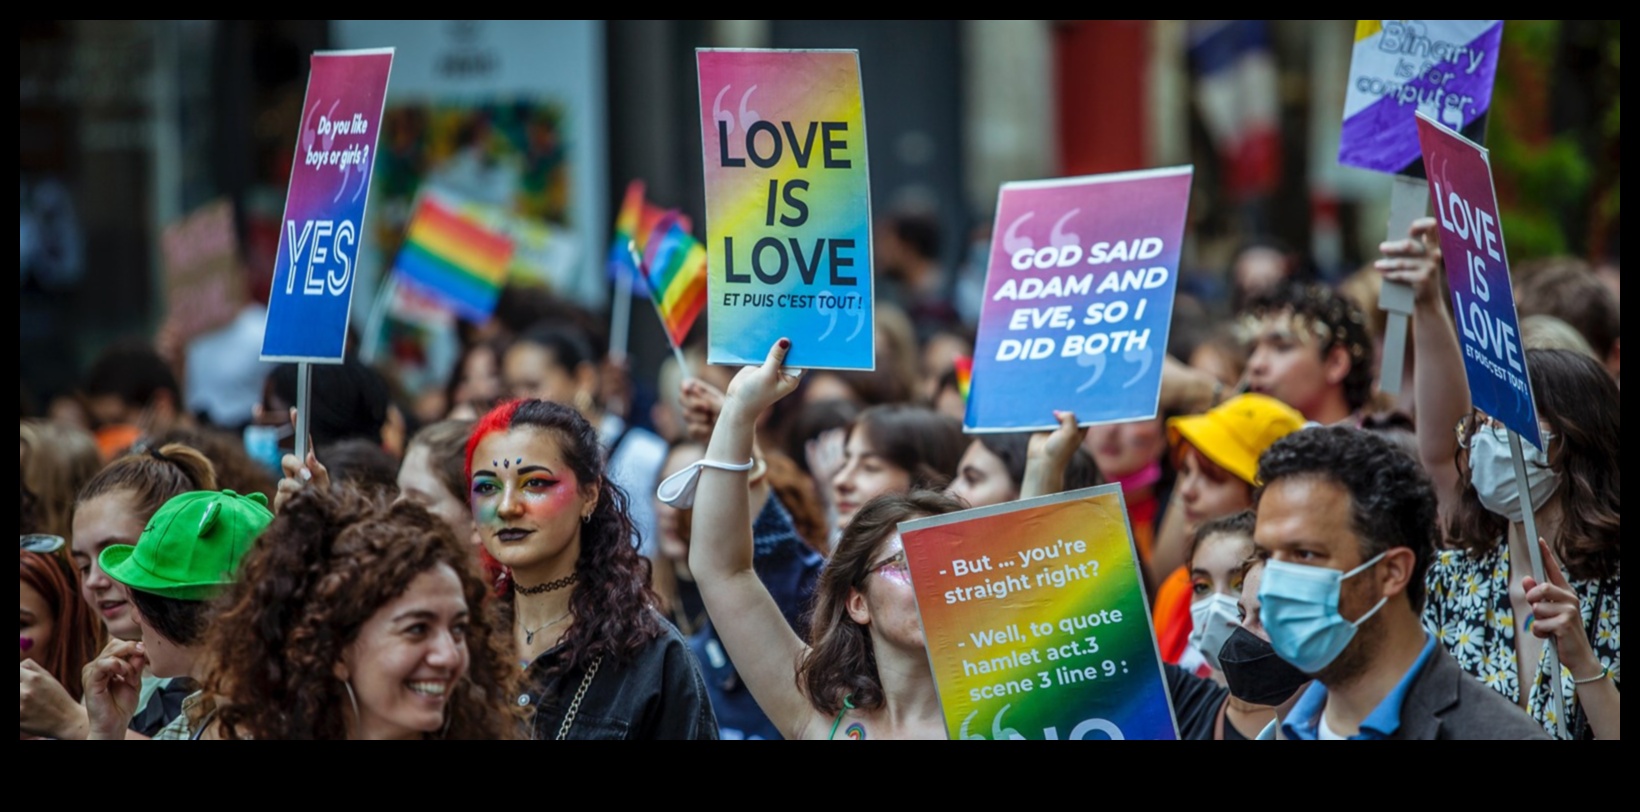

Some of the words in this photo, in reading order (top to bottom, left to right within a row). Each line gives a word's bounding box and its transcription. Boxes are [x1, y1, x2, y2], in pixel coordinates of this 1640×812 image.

[1378, 21, 1484, 74] Binary
[1418, 60, 1455, 87] for
[1356, 75, 1476, 116] computer.
[318, 116, 330, 135] Do
[331, 120, 350, 140] you
[350, 113, 368, 134] like
[718, 120, 852, 169] LOVE
[306, 144, 328, 170] boys
[330, 151, 341, 165] or
[765, 178, 810, 228] IS
[1434, 182, 1501, 263] LOVE
[286, 220, 355, 296] YES
[724, 236, 857, 286] LOVE
[1011, 244, 1083, 270] GOD
[1087, 237, 1164, 265] SAID
[992, 273, 1094, 301] ADAM
[1096, 267, 1169, 294] AND
[1467, 249, 1490, 302] IS
[722, 293, 740, 306] ET
[742, 293, 775, 308] PUIS
[777, 294, 814, 308] C'EST
[1008, 305, 1076, 330] EVE,
[1083, 300, 1129, 325] SO
[1134, 298, 1147, 320] I
[995, 337, 1056, 361] DID
[1060, 328, 1150, 358] BOTH
[1455, 291, 1522, 373] LOVE
[1466, 343, 1474, 358] ET
[952, 556, 992, 577] But
[1018, 538, 1087, 567] you're
[944, 574, 1031, 604] straight
[1036, 560, 1100, 588] right?
[970, 624, 1026, 649] Well,
[1030, 621, 1054, 638] to
[1058, 609, 1123, 635] quote
[962, 649, 1042, 677] hamlet
[1046, 636, 1100, 661] act.3
[969, 678, 1033, 702] scene
[1038, 672, 1052, 689] 3
[1055, 664, 1097, 686] line
[1101, 659, 1116, 676] 9
